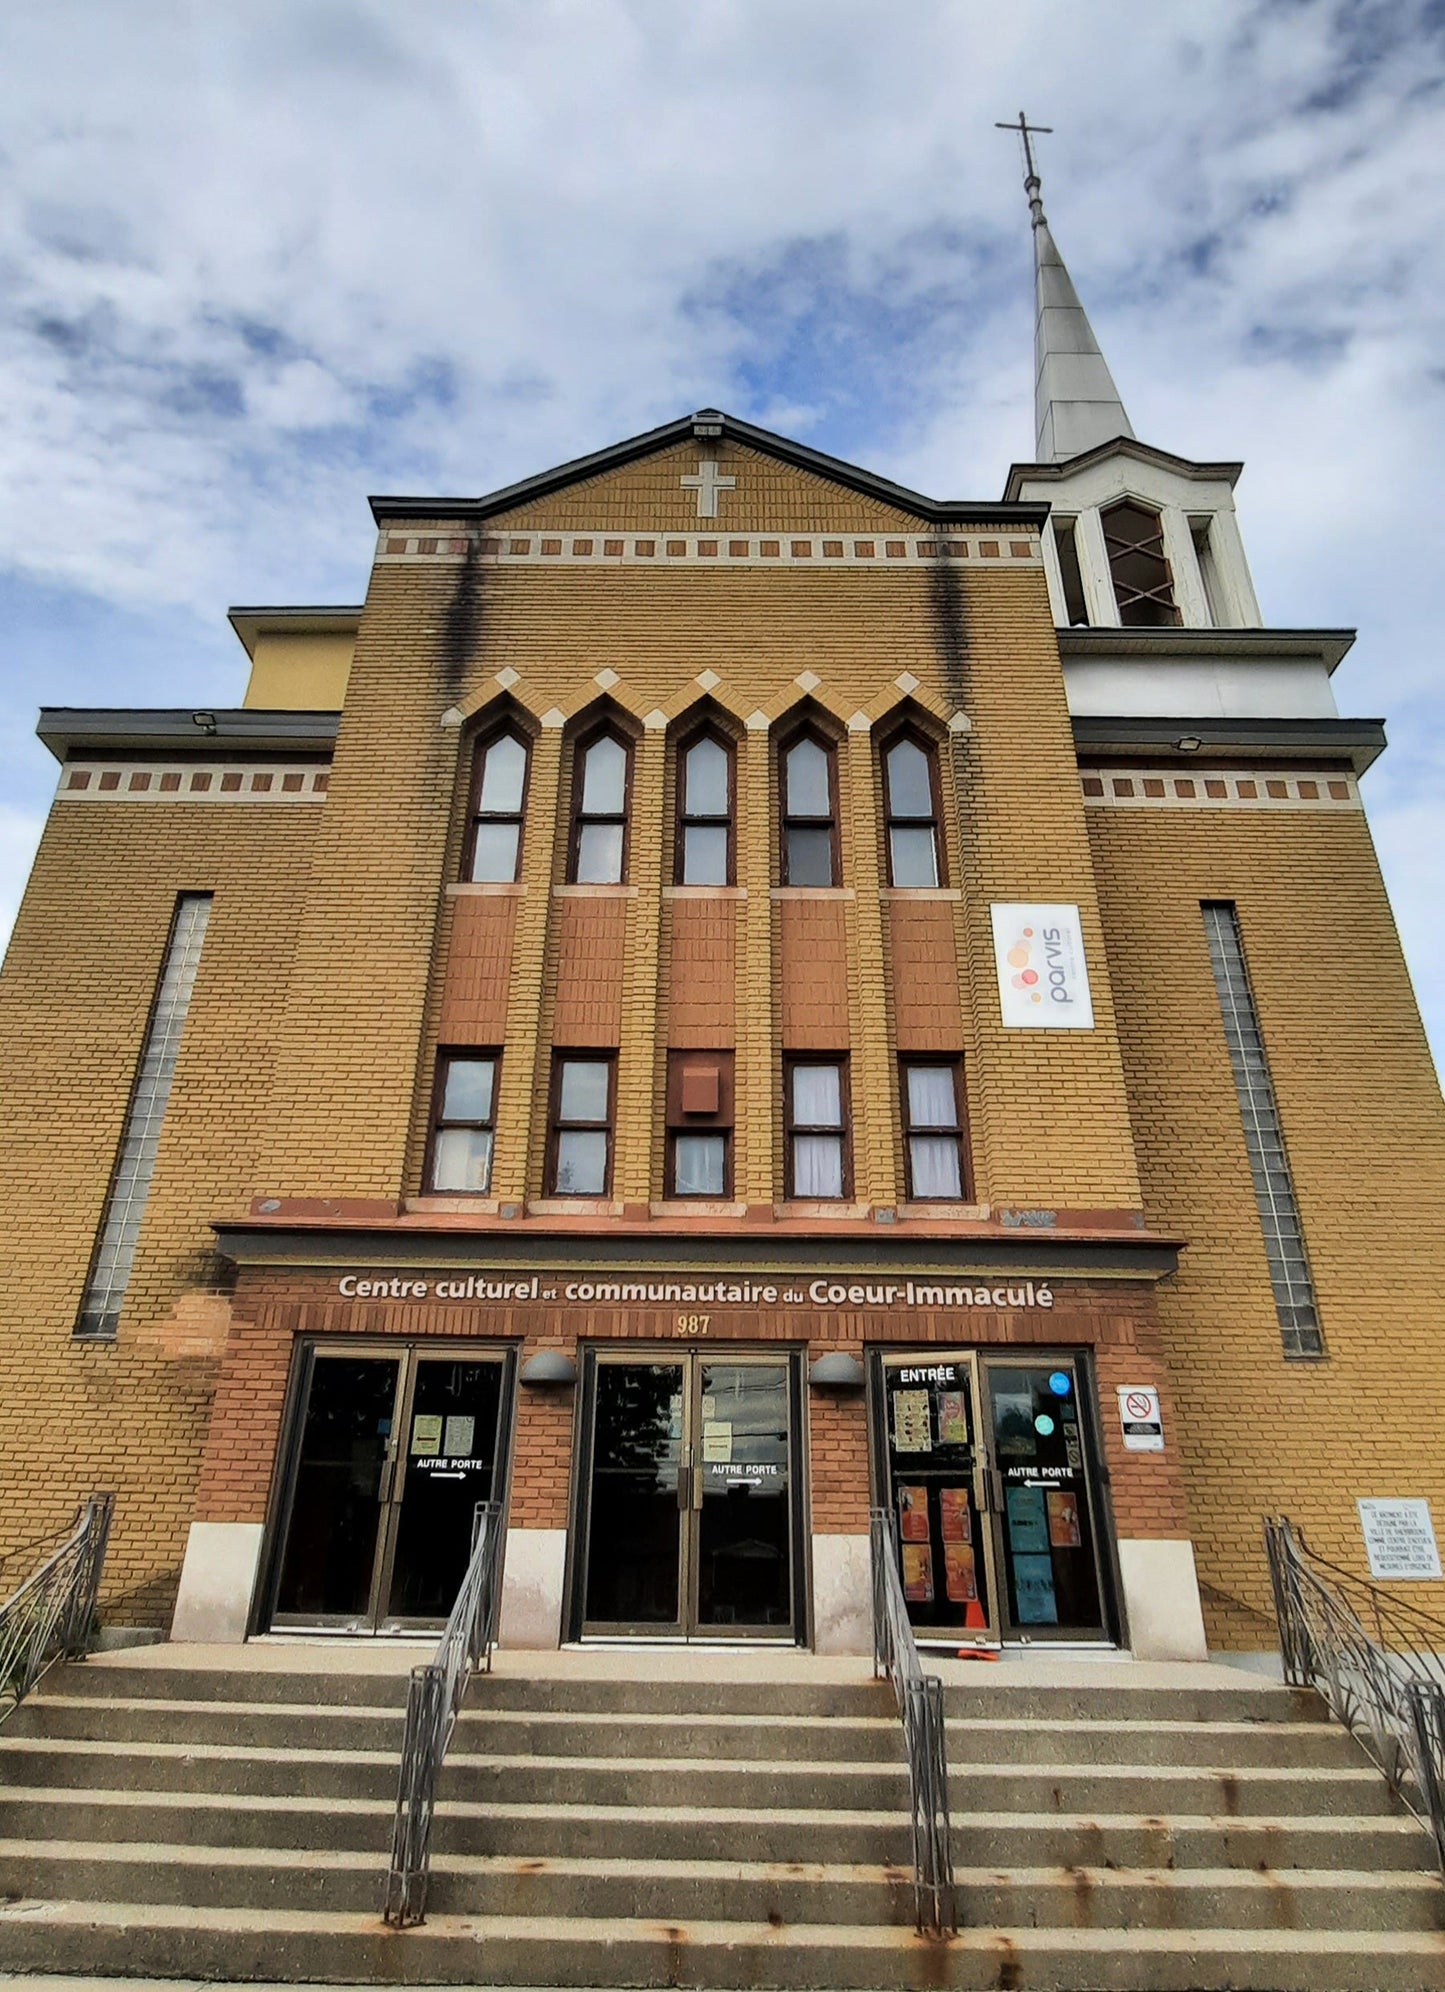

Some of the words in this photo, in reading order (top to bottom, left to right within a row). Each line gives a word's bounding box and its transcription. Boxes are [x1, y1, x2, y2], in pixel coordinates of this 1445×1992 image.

[1043, 928, 1074, 1003] parvis
[338, 1275, 427, 1298] Centre
[435, 1276, 539, 1300] culturel
[542, 1288, 557, 1300] et
[565, 1280, 778, 1303] communautaire
[783, 1288, 804, 1303] du
[809, 1280, 1054, 1308] Coeur-Immaculé
[677, 1315, 712, 1335] 987
[900, 1364, 955, 1383] ENTRÉE
[417, 1459, 448, 1469] AUTRE
[451, 1459, 483, 1470] PORTE
[711, 1465, 742, 1475] AUTRE
[746, 1465, 777, 1475] PORTE
[1007, 1466, 1039, 1477] AUTRE
[1042, 1467, 1074, 1478] PORTE
